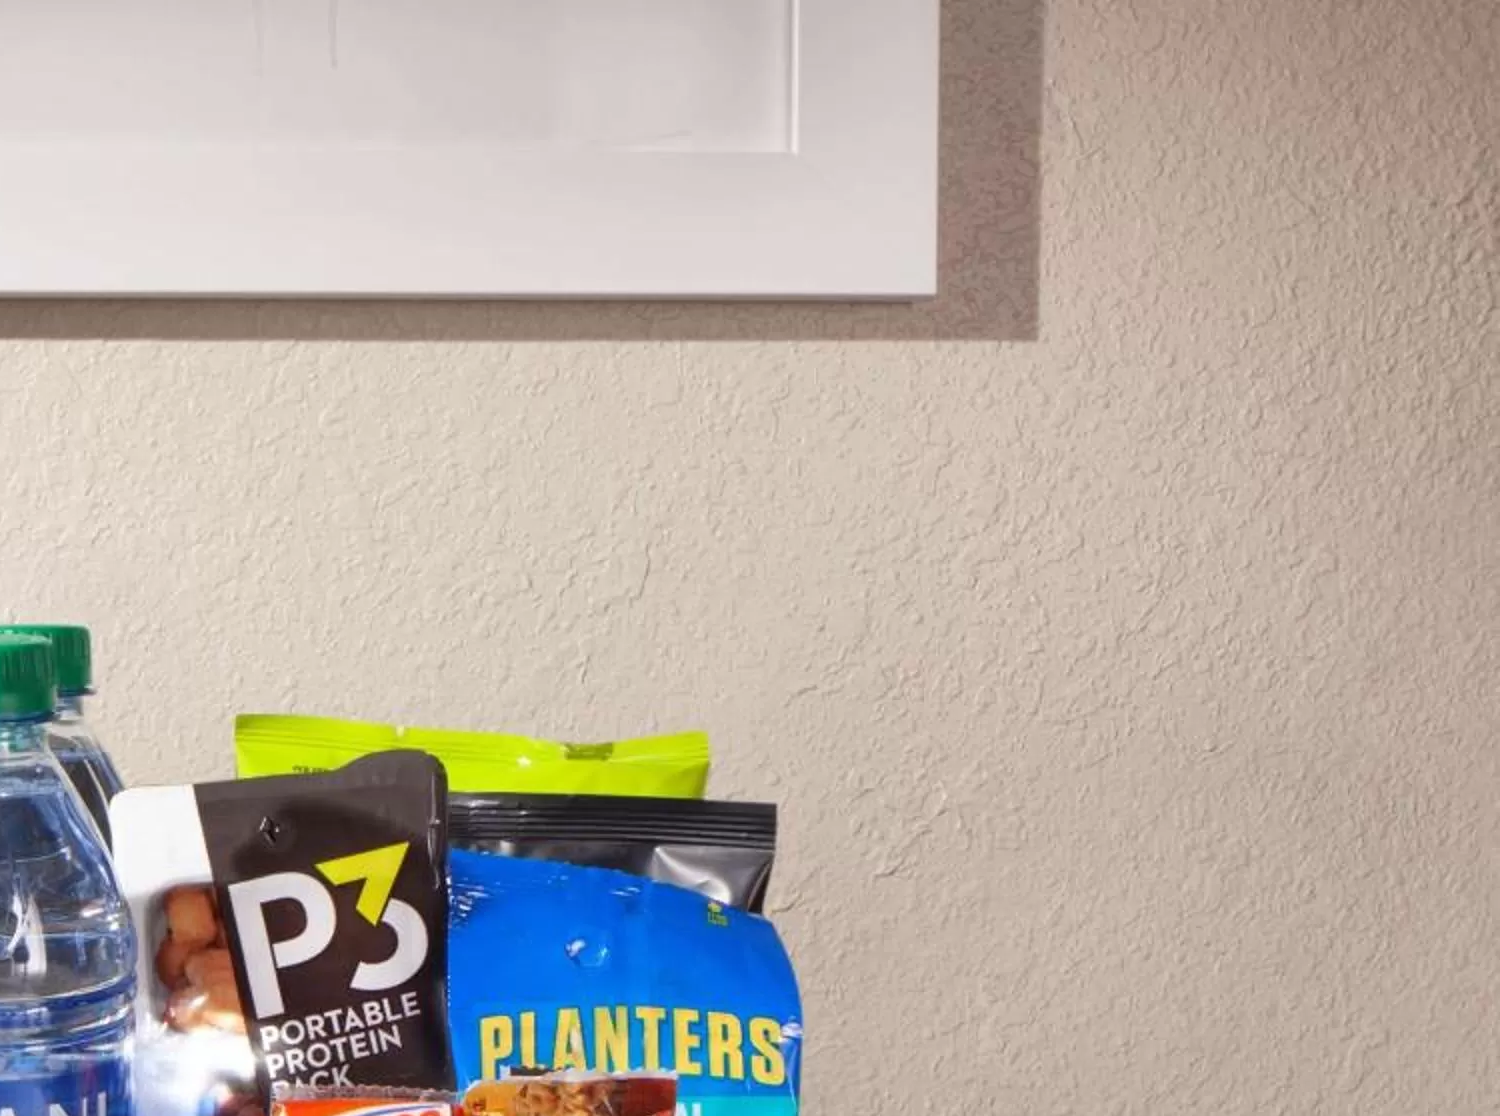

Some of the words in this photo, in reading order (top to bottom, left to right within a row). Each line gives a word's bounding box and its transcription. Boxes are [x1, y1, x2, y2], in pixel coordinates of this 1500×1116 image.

[227, 840, 429, 1020] P3
[260, 991, 421, 1052] PORTABLE
[265, 1024, 403, 1080] PROTEIN
[479, 1005, 787, 1087] PLANTERS
